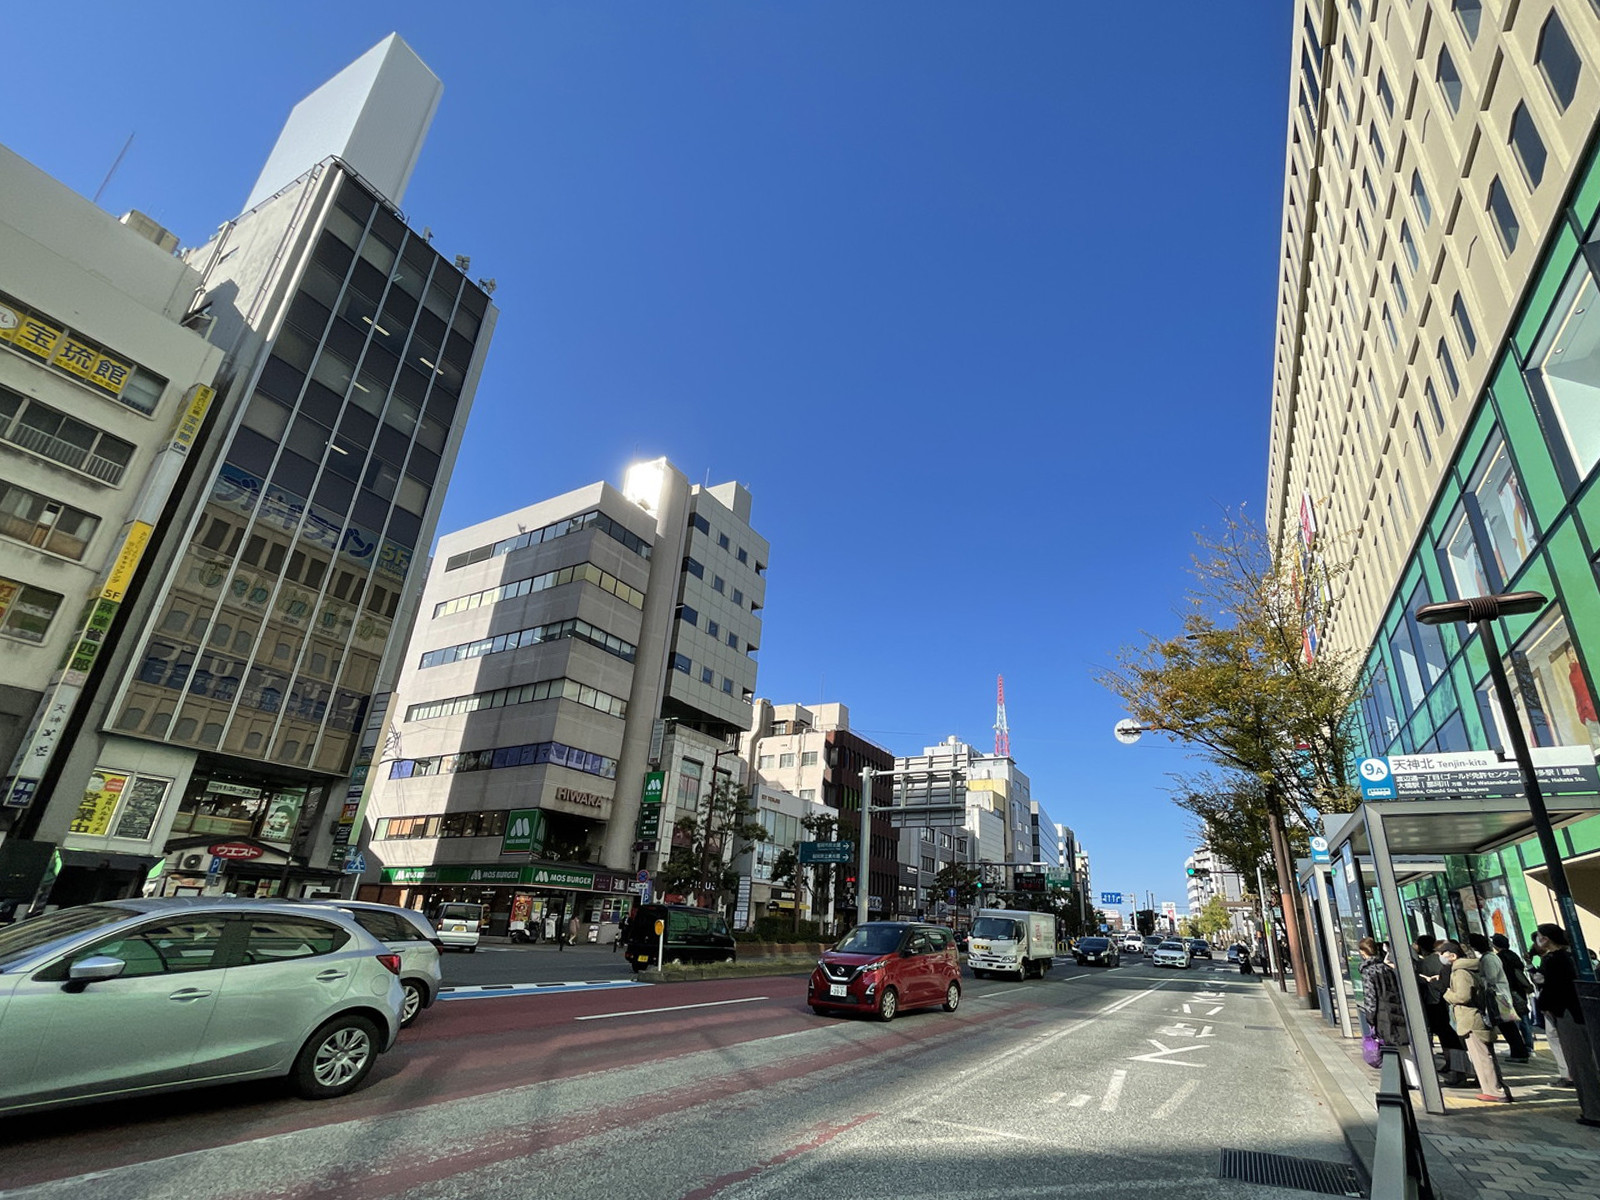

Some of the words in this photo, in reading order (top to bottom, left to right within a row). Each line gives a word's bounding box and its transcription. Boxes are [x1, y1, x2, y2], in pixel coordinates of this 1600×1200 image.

[1363, 763, 1385, 777] 9A
[1392, 757, 1435, 771] 天神北
[1436, 758, 1488, 770] Tenjin-kita
[216, 846, 258, 856] ウエスト
[495, 870, 519, 879] BURGER
[549, 873, 566, 882] MOS
[566, 874, 592, 885] BURGER
